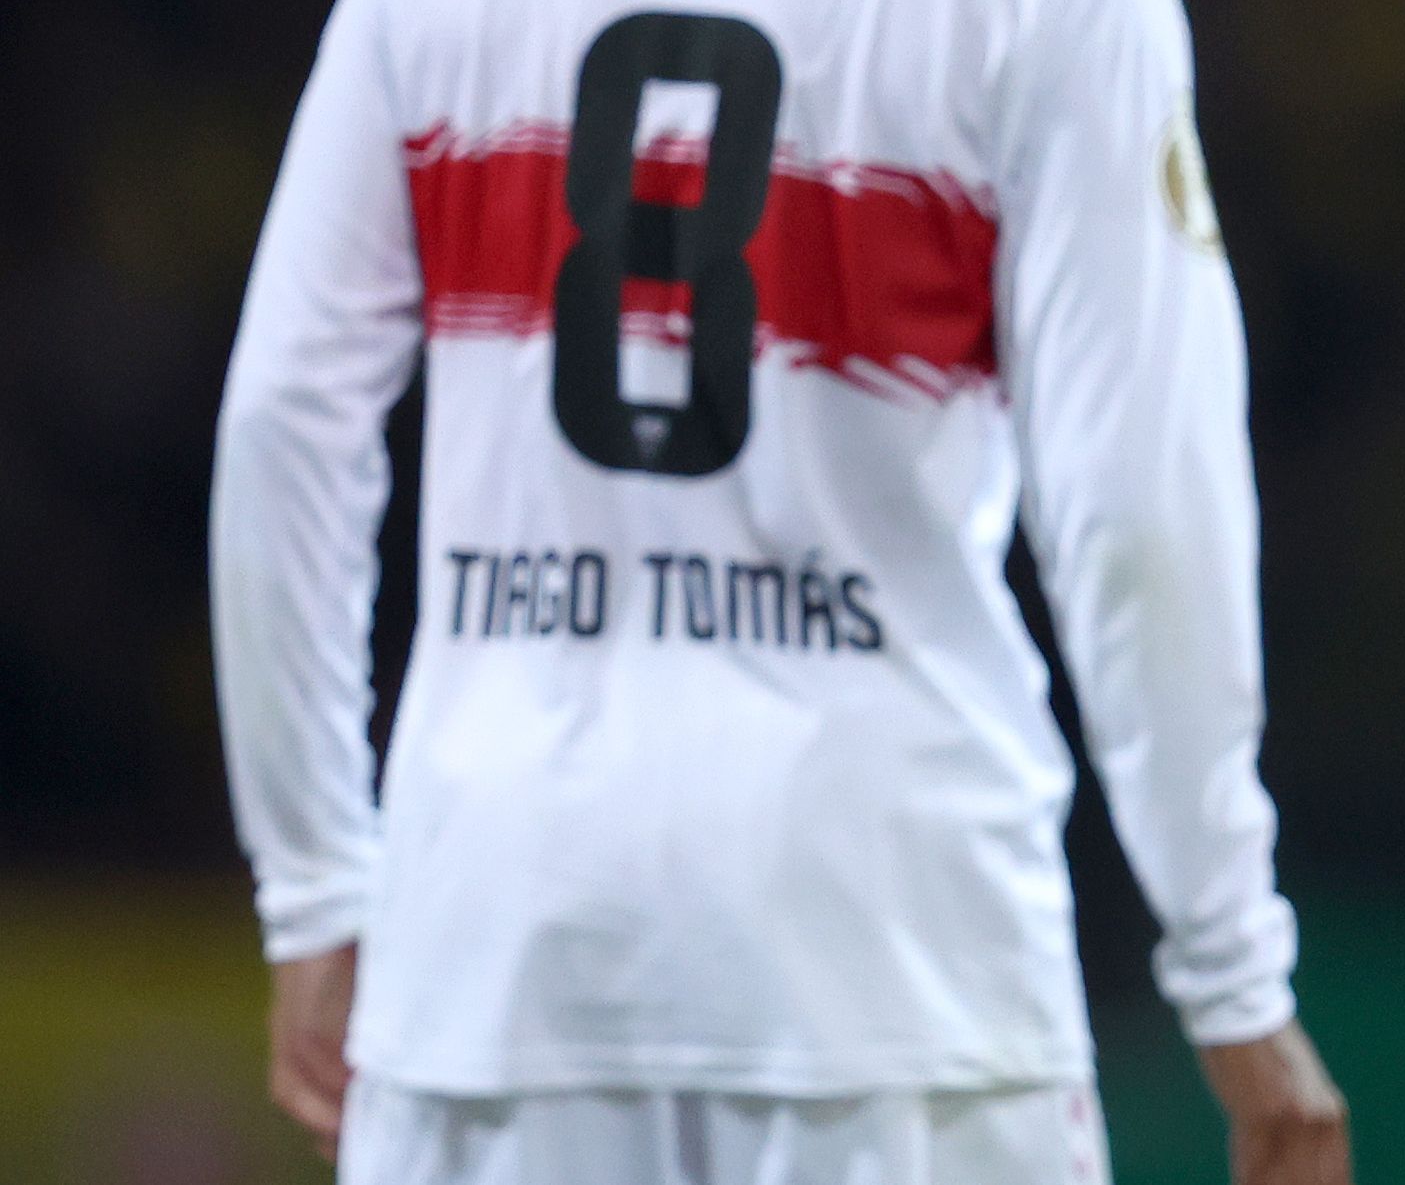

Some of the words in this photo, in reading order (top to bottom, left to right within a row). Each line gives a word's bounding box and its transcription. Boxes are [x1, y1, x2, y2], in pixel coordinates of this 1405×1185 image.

[553, 12, 782, 475] 8
[448, 550, 606, 637] TIAGO
[646, 547, 884, 651] TOMÁS
